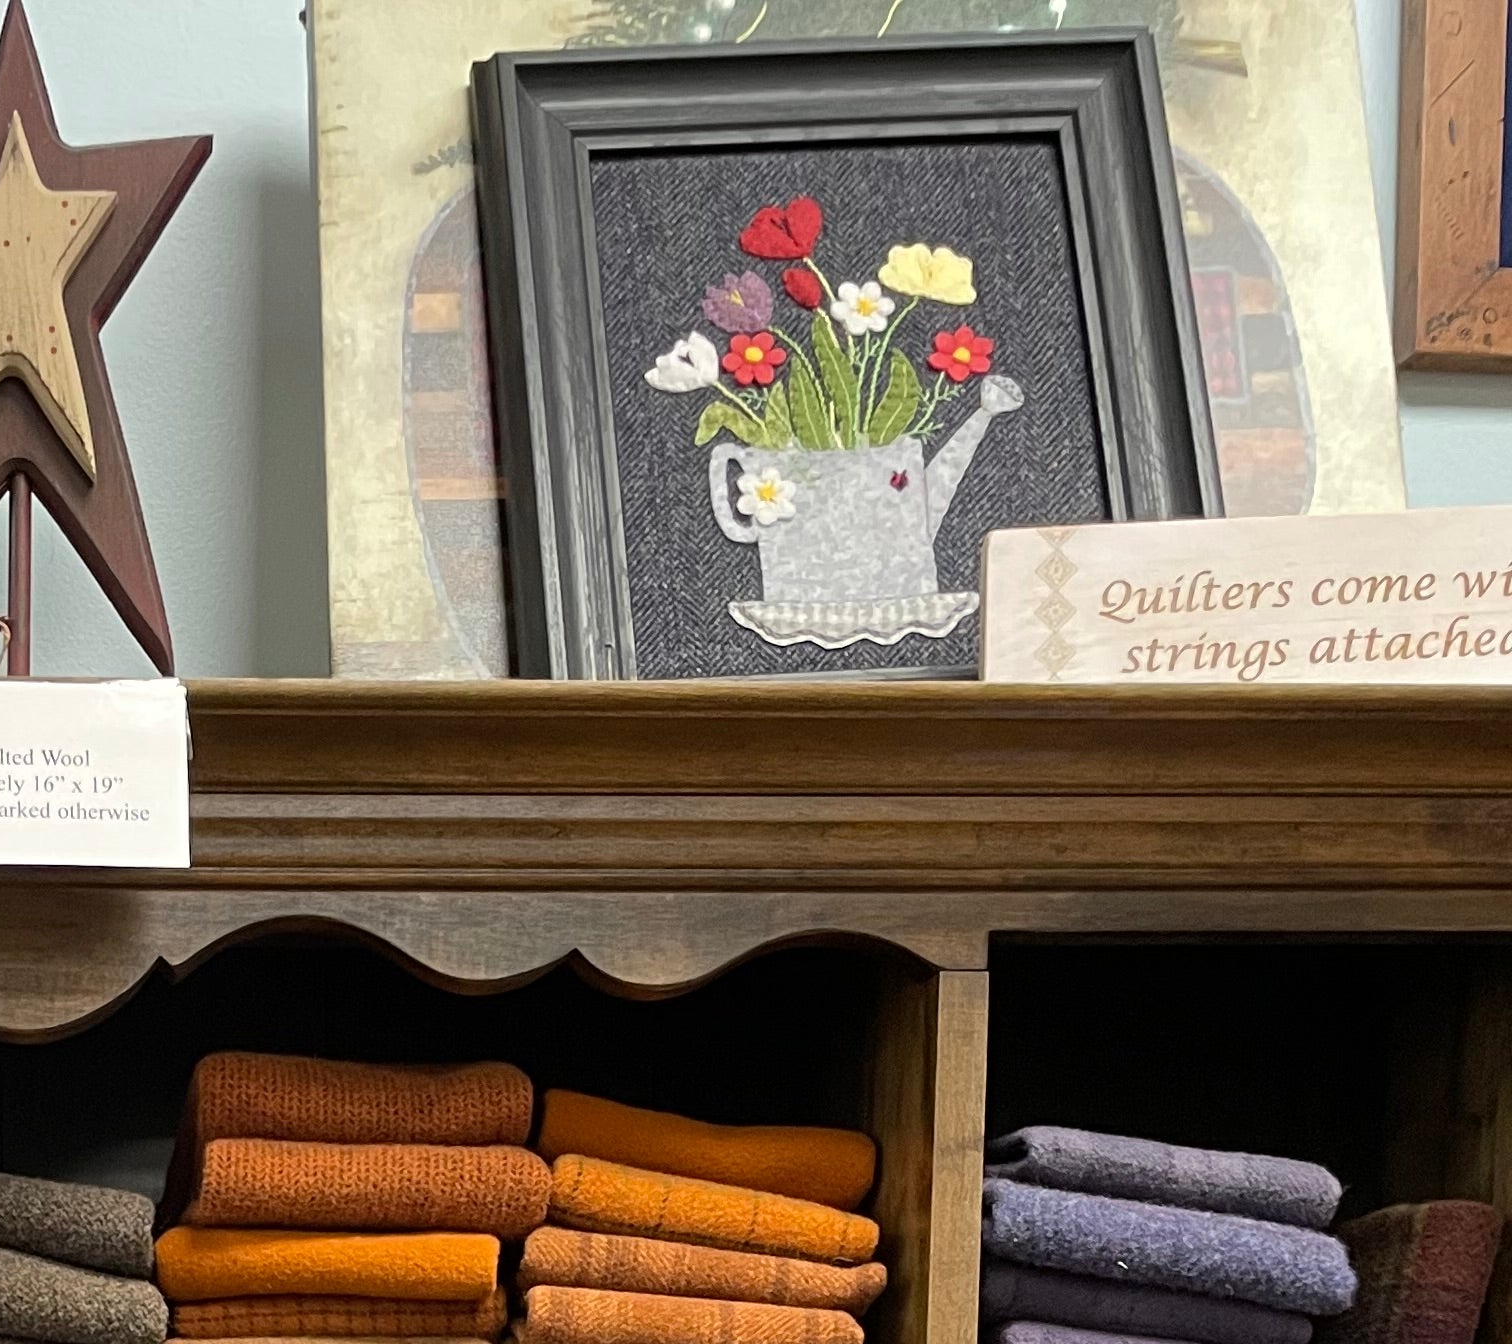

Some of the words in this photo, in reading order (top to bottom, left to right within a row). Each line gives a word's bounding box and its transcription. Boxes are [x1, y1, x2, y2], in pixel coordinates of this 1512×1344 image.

[1098, 569, 1293, 625] Quilters
[1311, 571, 1437, 606] come
[1121, 632, 1290, 682] strings
[41, 749, 91, 768] Wool
[71, 781, 83, 793] x
[57, 803, 151, 822] otherwise
